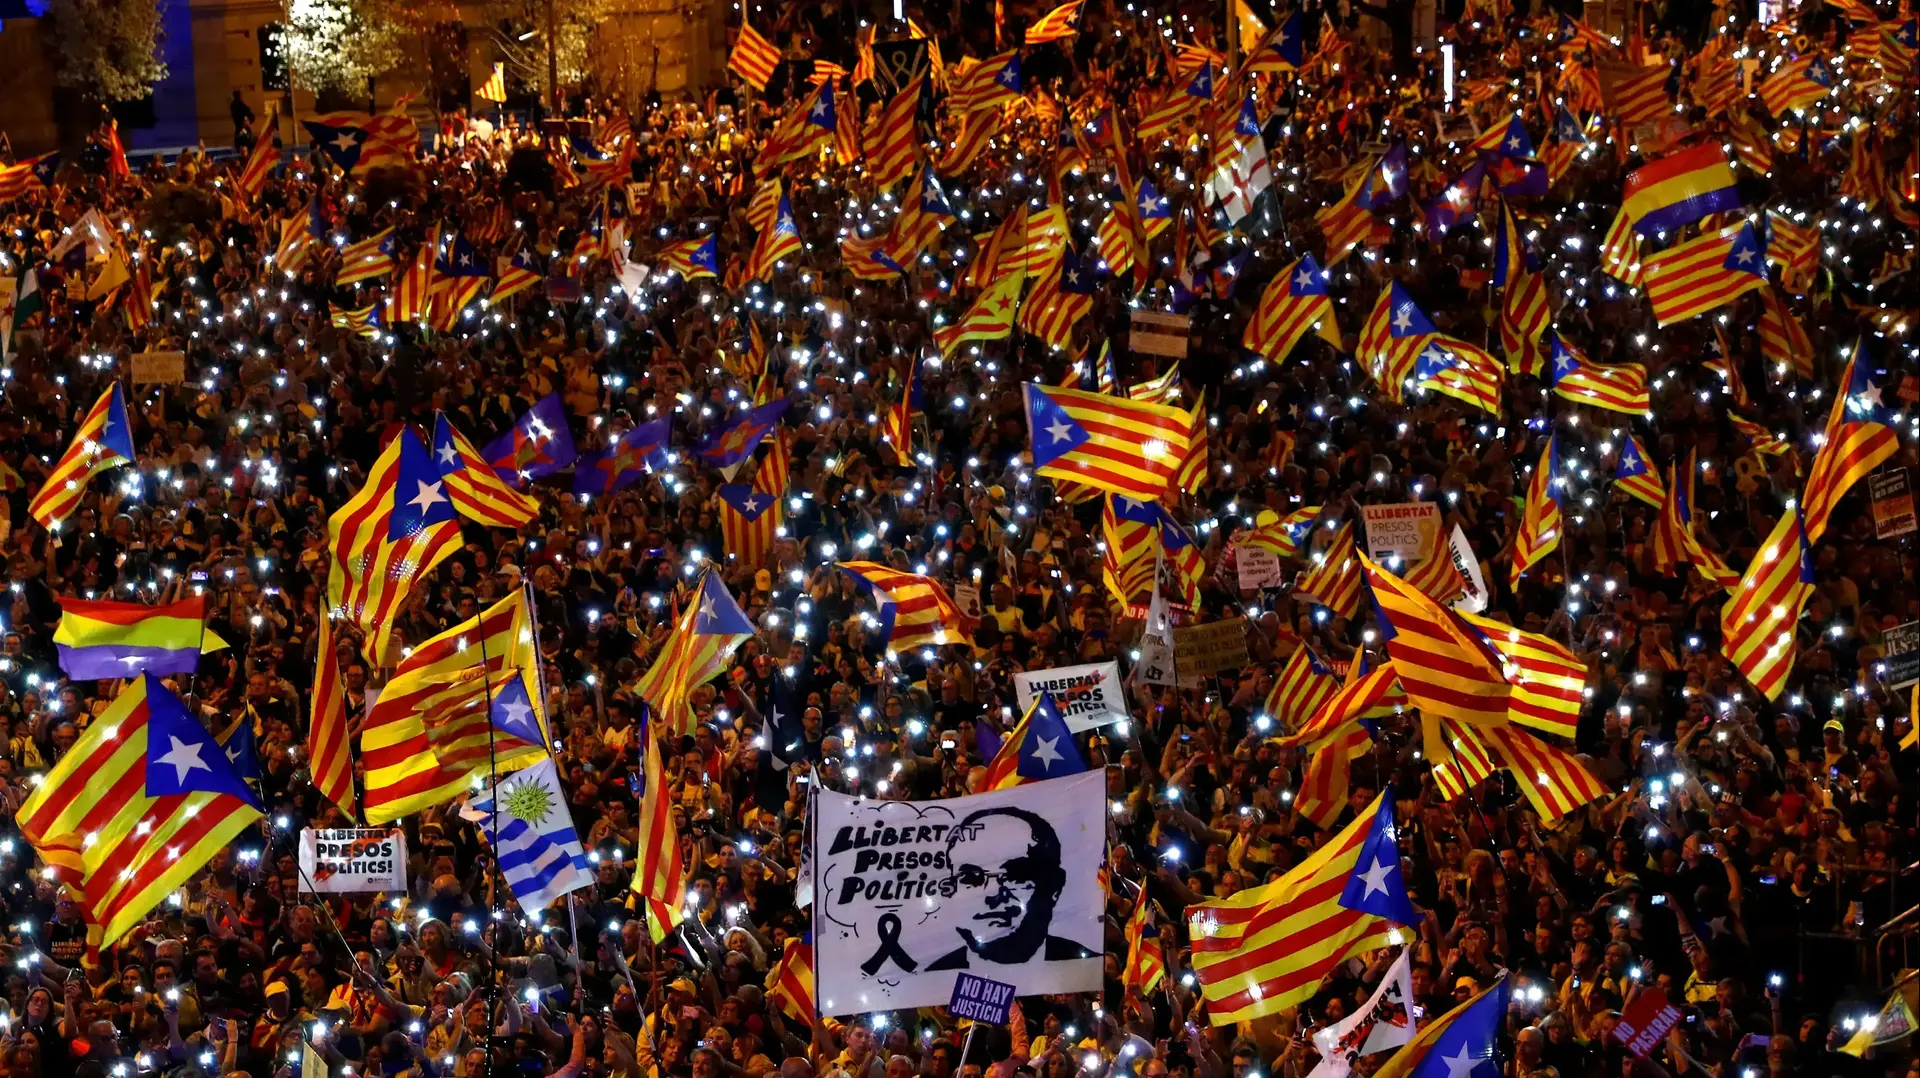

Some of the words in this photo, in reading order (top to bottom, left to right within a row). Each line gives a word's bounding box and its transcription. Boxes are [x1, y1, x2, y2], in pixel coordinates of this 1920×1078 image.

[1367, 506, 1433, 519] LLIBERTAT
[1372, 521, 1414, 532] PRESOS
[1371, 533, 1418, 546] POLÍTICS
[315, 829, 391, 841] LLIBERTAT
[316, 843, 393, 858] PRESOS
[853, 849, 947, 874] PRESOS
[960, 976, 981, 999] NO
[981, 982, 1012, 1006] HAY
[1612, 1021, 1636, 1044] NO
